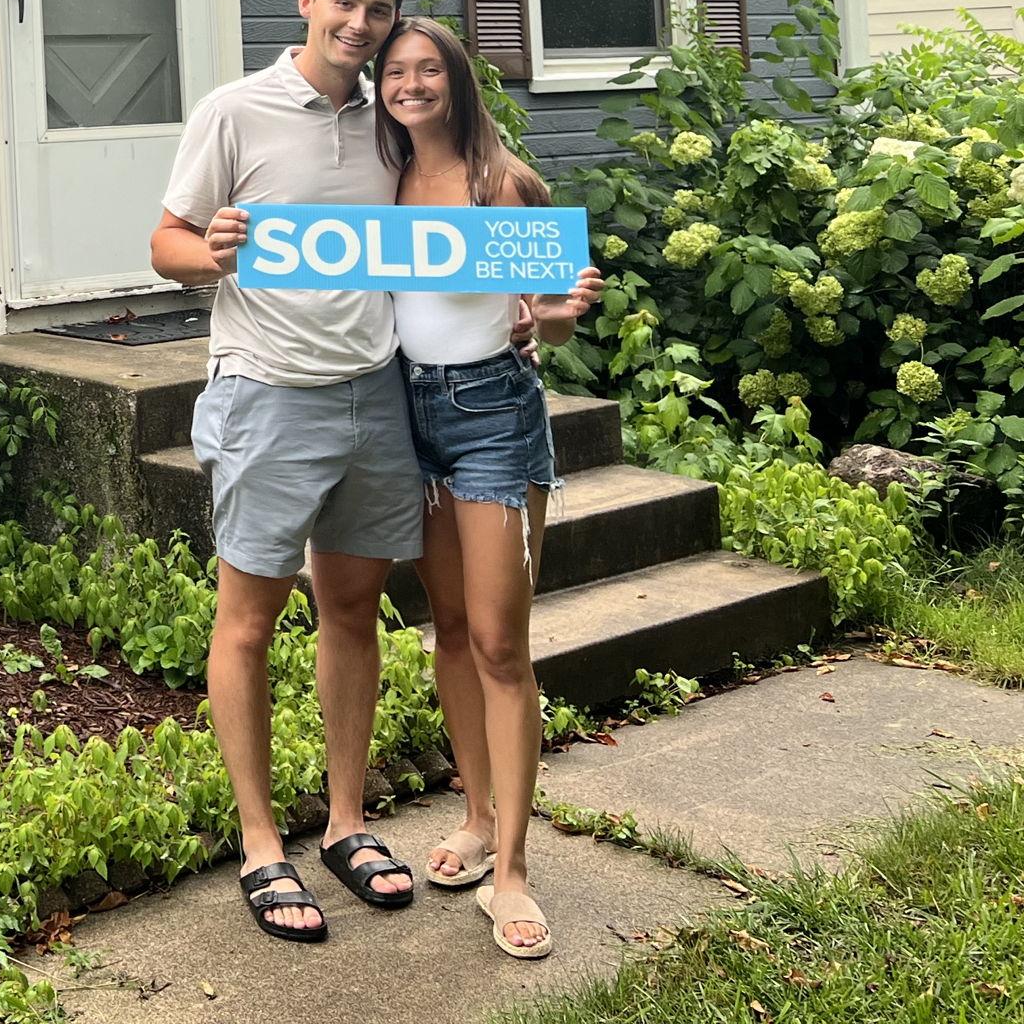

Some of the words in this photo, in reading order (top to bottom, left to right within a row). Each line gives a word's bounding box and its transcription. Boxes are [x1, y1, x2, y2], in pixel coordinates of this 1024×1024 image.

[484, 220, 560, 239] YOURS
[252, 217, 467, 278] SOLD
[485, 241, 562, 259] COULD
[476, 261, 503, 279] BE
[510, 262, 574, 280] NEXT!
